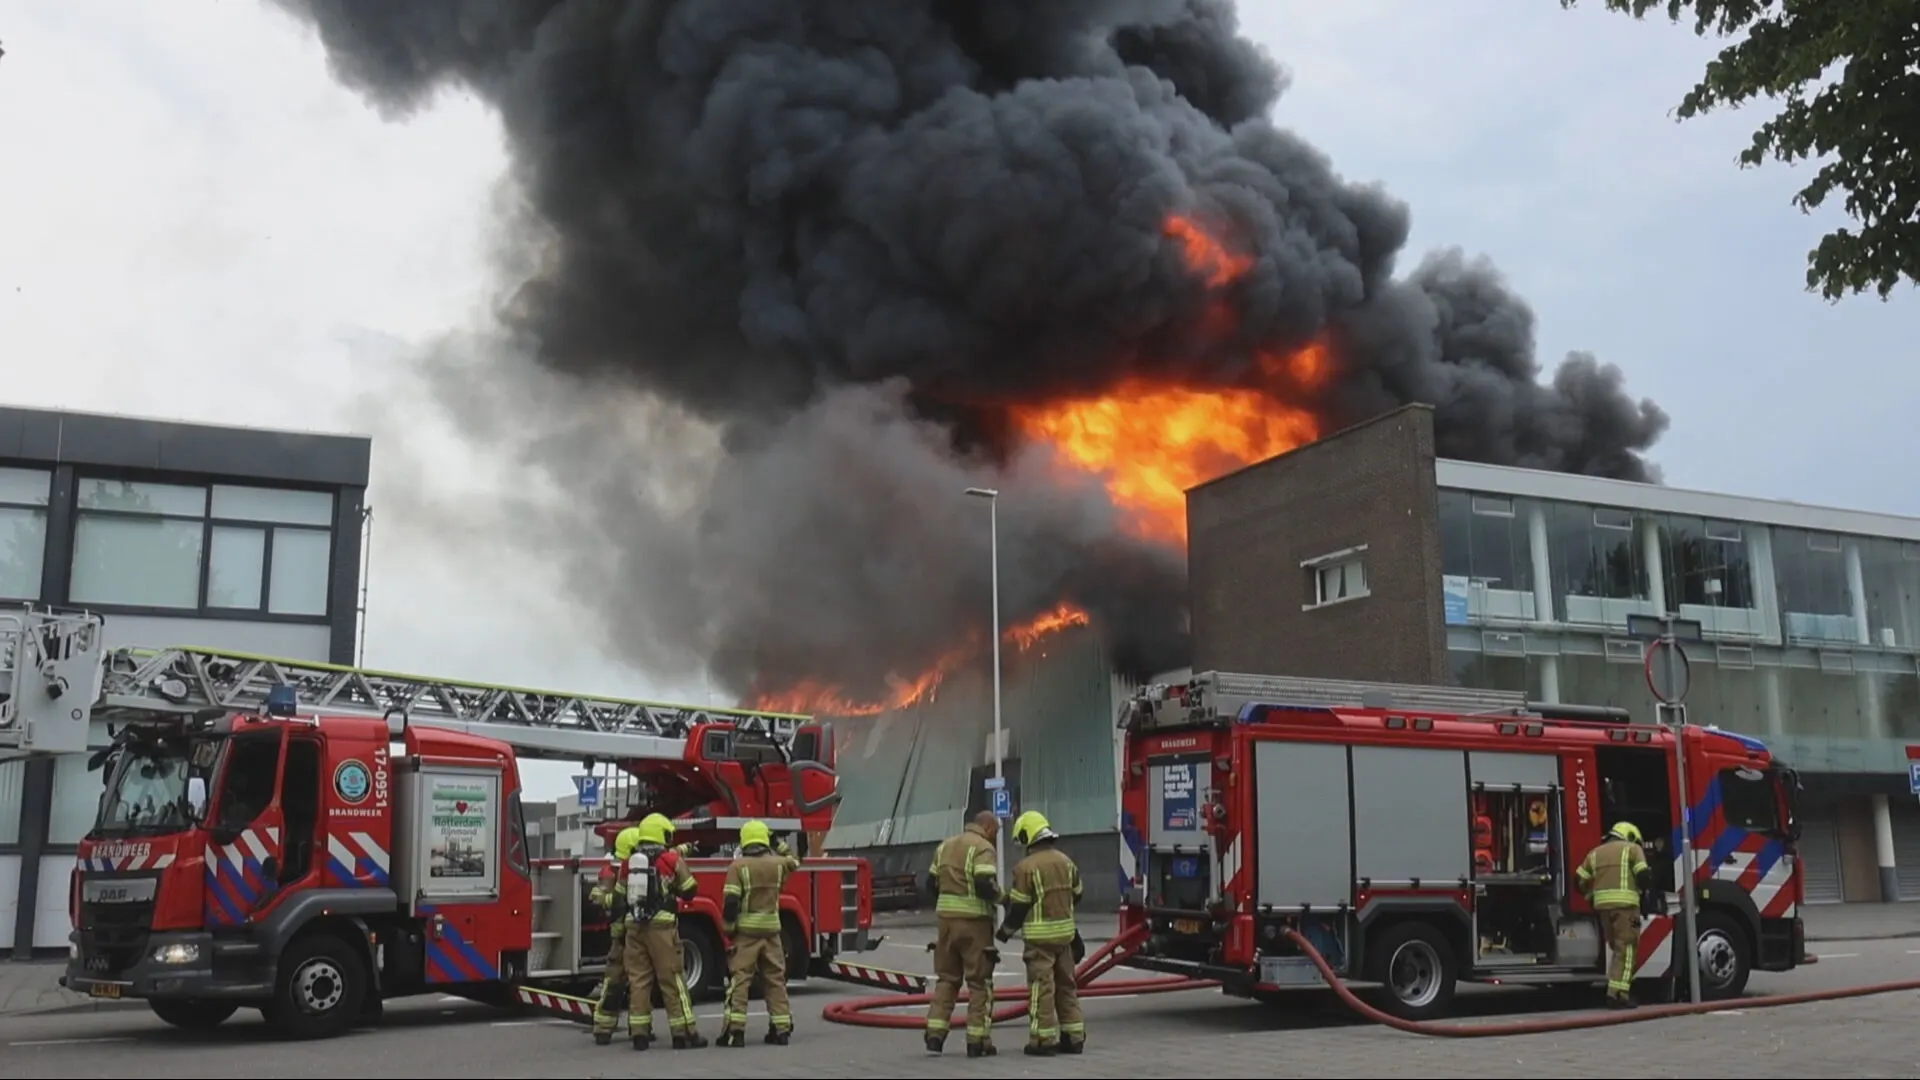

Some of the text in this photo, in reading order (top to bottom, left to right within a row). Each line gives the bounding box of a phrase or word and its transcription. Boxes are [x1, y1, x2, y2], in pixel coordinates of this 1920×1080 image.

[374, 748, 387, 807] 17-0951
[583, 777, 595, 795] P
[996, 792, 1006, 807] P
[1576, 770, 1588, 824] 17-0631
[329, 808, 382, 817] BRANDWEER
[434, 816, 482, 828] Rotterdam
[92, 843, 151, 858] BRANDWEER
